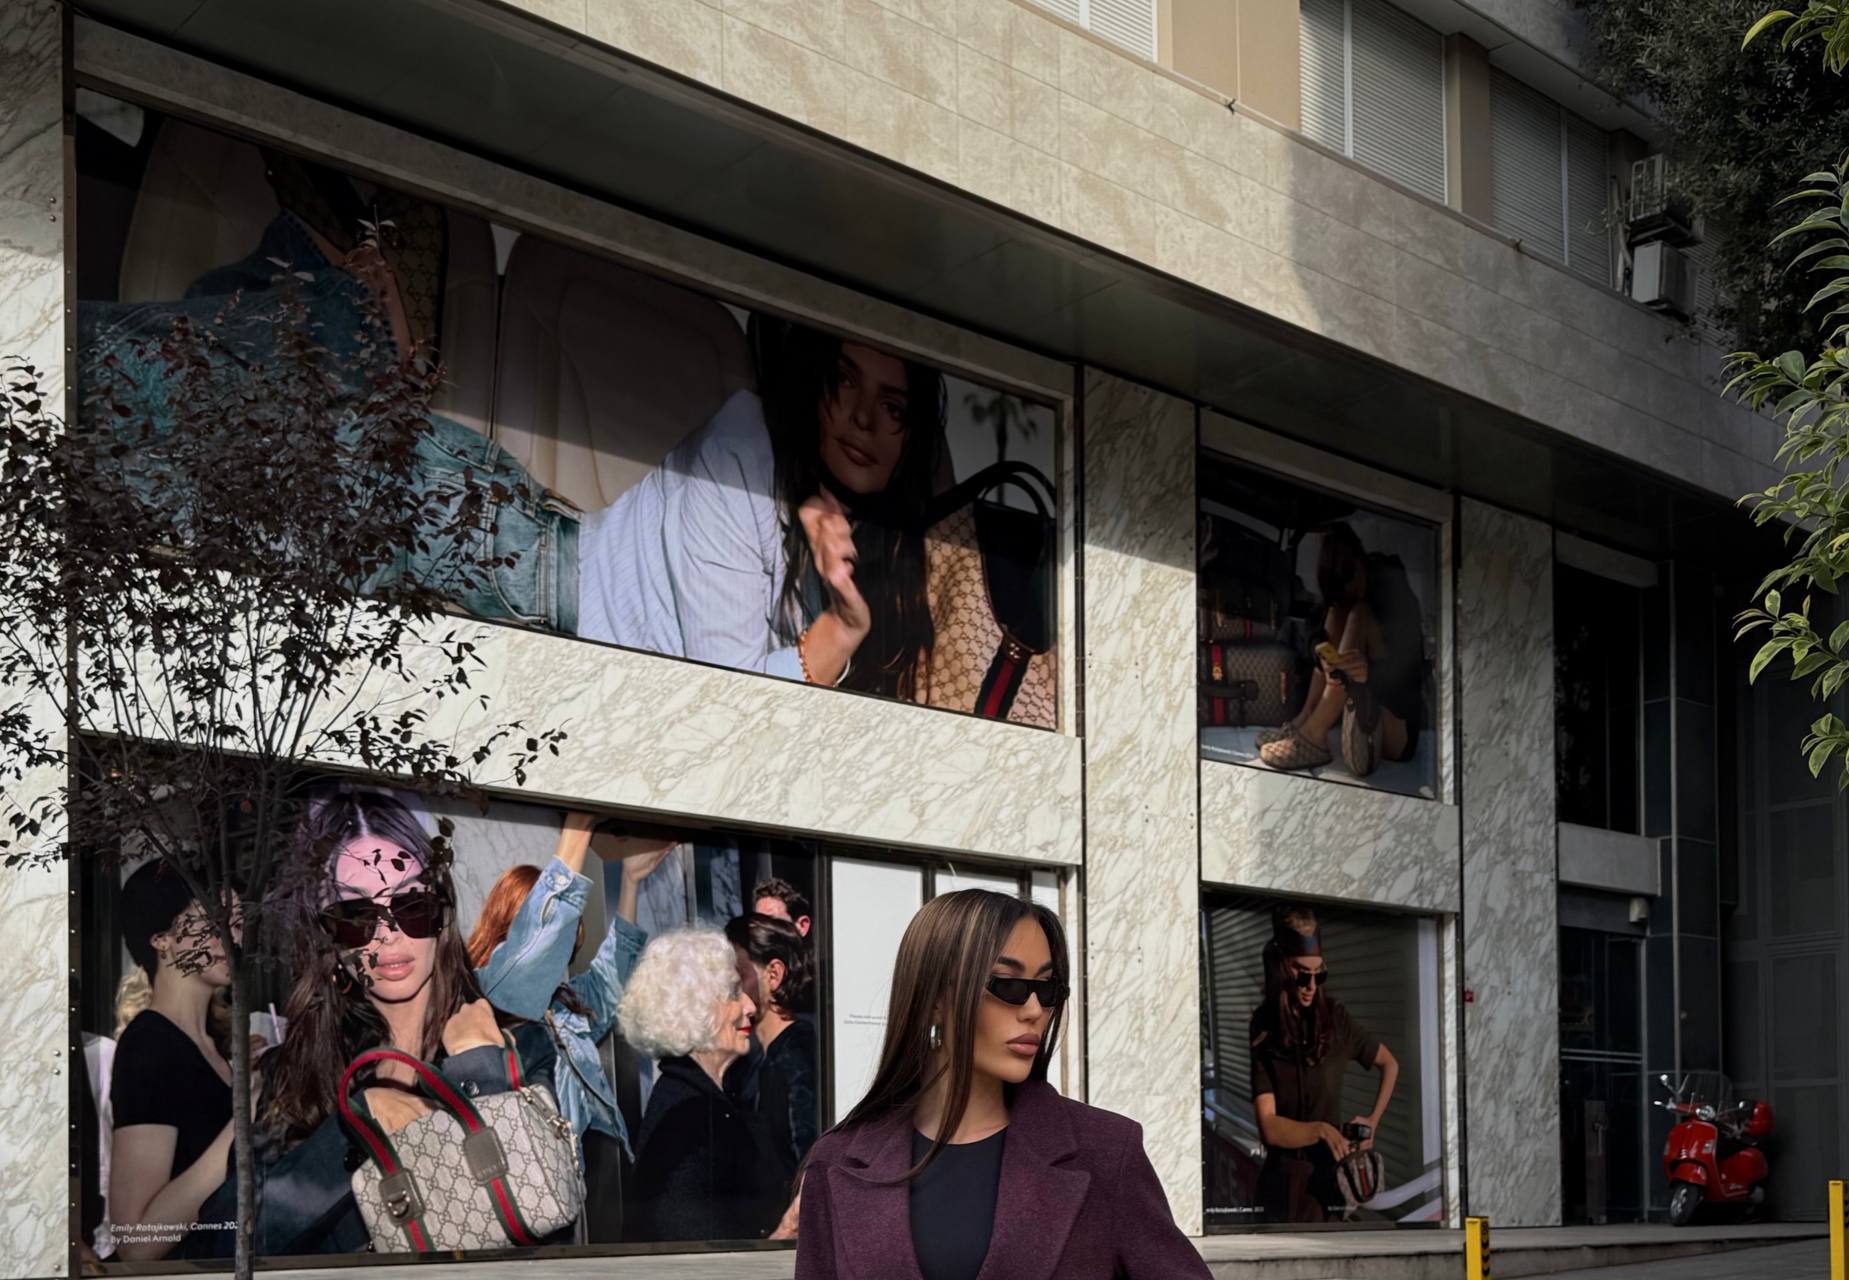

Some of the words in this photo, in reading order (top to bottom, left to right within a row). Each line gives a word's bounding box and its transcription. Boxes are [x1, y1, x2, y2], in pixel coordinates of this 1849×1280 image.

[110, 1223, 134, 1233] Emily
[136, 1222, 189, 1232] Ratajkowski,
[190, 1222, 222, 1231] Cannes
[110, 1235, 121, 1245] By
[123, 1234, 152, 1244] Daniel
[153, 1234, 182, 1243] Arnold
